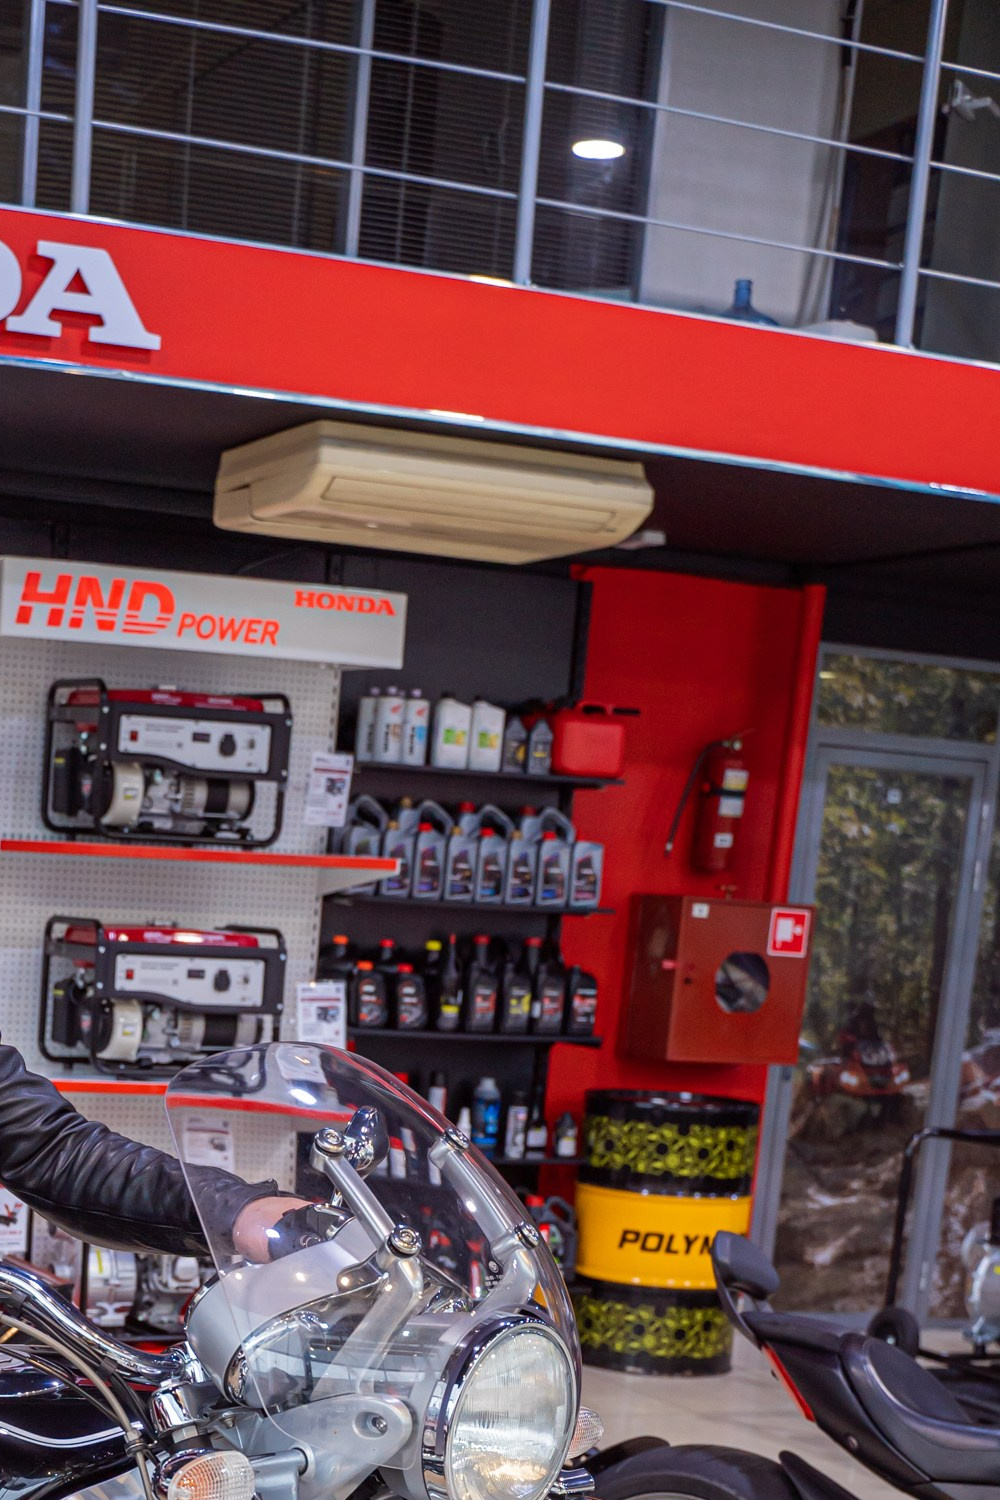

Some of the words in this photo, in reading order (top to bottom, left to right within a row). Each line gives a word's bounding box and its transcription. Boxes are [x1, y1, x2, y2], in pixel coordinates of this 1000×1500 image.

[14, 571, 176, 635] HND
[177, 612, 281, 646] POWER
[294, 590, 397, 617] HONDA
